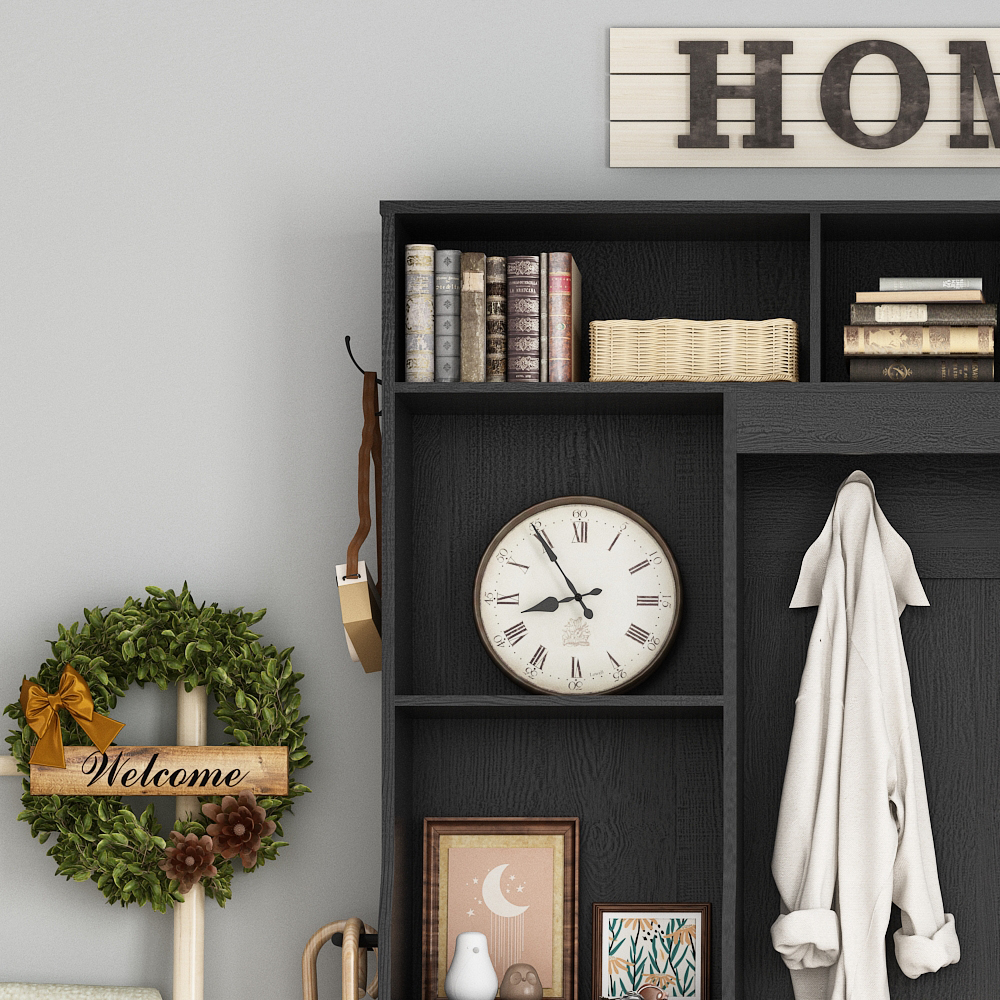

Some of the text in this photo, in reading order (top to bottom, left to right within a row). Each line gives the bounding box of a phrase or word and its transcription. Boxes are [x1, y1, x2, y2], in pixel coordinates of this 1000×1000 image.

[572, 509, 588, 518] 60
[571, 521, 588, 543] XII
[496, 548, 508, 563] 50
[649, 551, 662, 565] 10
[484, 591, 494, 606] 45
[662, 595, 671, 609] 15
[493, 634, 506, 648] 40
[647, 636, 661, 651] 20
[81, 749, 251, 788] Welcome
